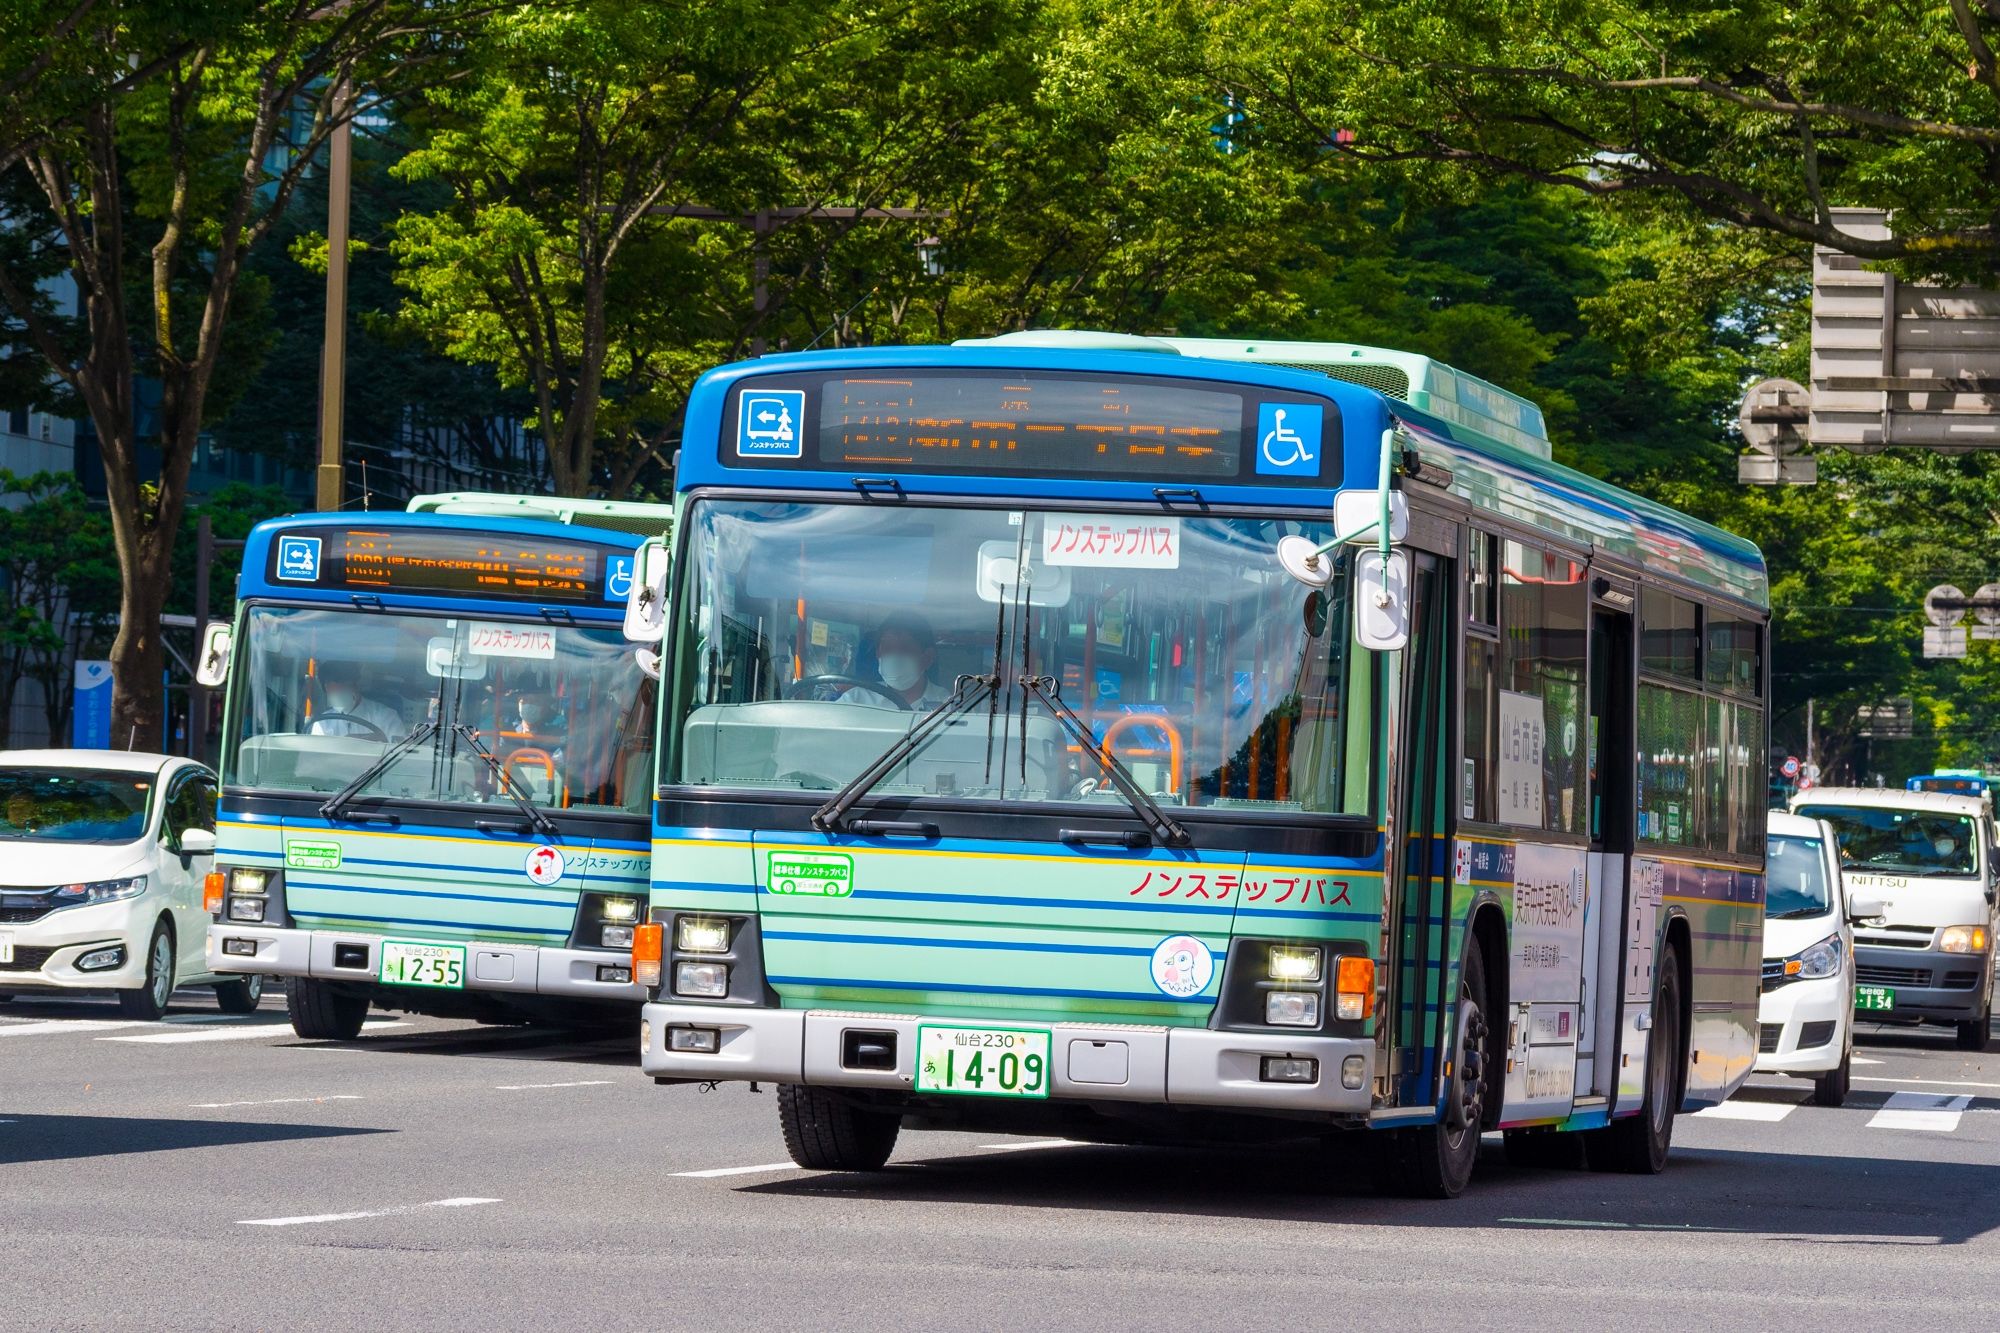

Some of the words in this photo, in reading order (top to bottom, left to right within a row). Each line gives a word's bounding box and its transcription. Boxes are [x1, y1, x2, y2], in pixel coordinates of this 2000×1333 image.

[1050, 524, 1173, 556] ノンステップバス
[473, 629, 551, 650] ノンステップバス
[1502, 713, 1540, 765] 仙台市営
[1130, 872, 1352, 906] ノンステップバス
[1851, 876, 1907, 888] NITTSU
[1515, 877, 1573, 928] 東京中央美容外科
[400, 957, 461, 984] 12-55
[924, 1061, 936, 1074] あ
[946, 1049, 1043, 1091] 14-09
